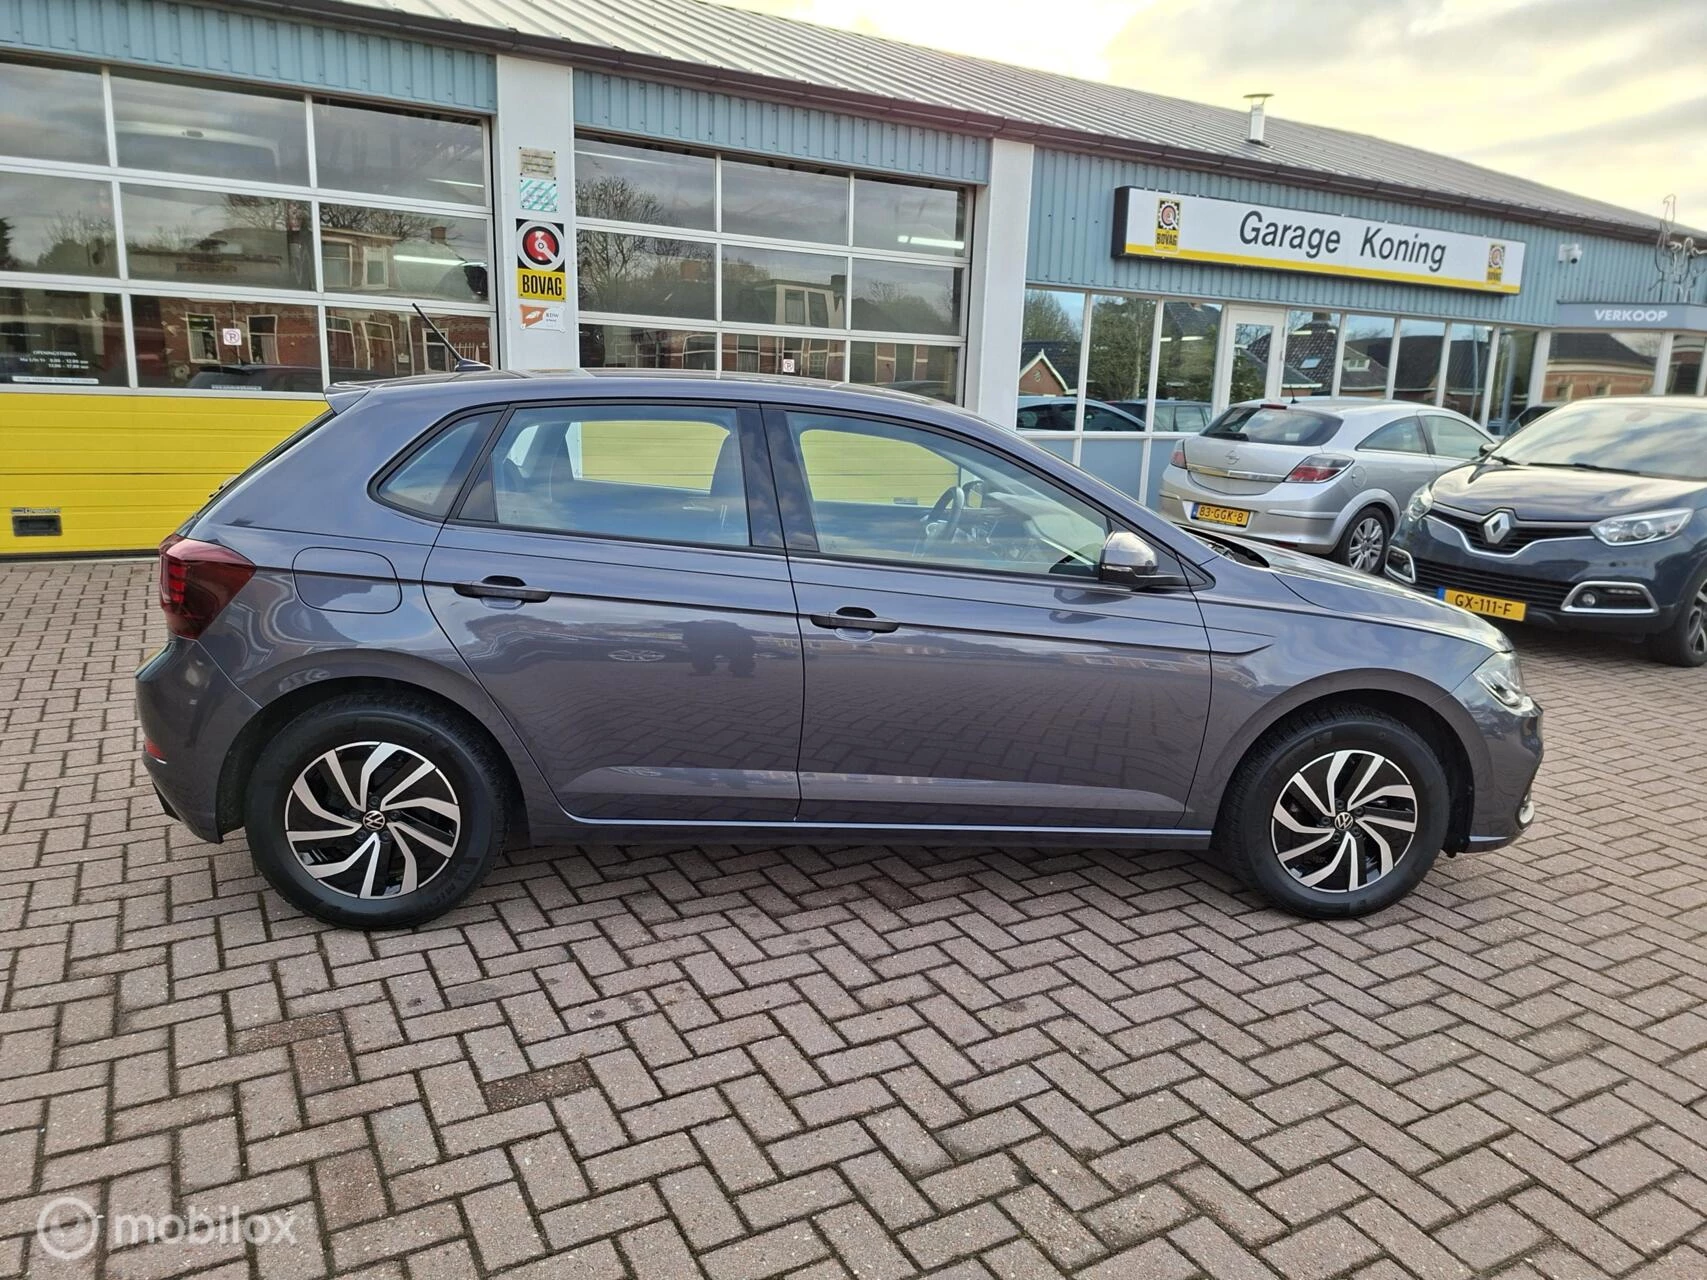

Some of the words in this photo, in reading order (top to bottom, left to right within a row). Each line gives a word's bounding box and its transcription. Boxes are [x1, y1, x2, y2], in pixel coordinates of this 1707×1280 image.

[1156, 232, 1178, 246] BOVAG
[1239, 210, 1341, 259] Garage
[1359, 226, 1446, 272] Koning
[522, 274, 562, 296] BOVAG
[1594, 309, 1668, 322] VERKOOP
[1199, 506, 1244, 522] 83-GGK-8
[1455, 594, 1512, 615] GX-111-F
